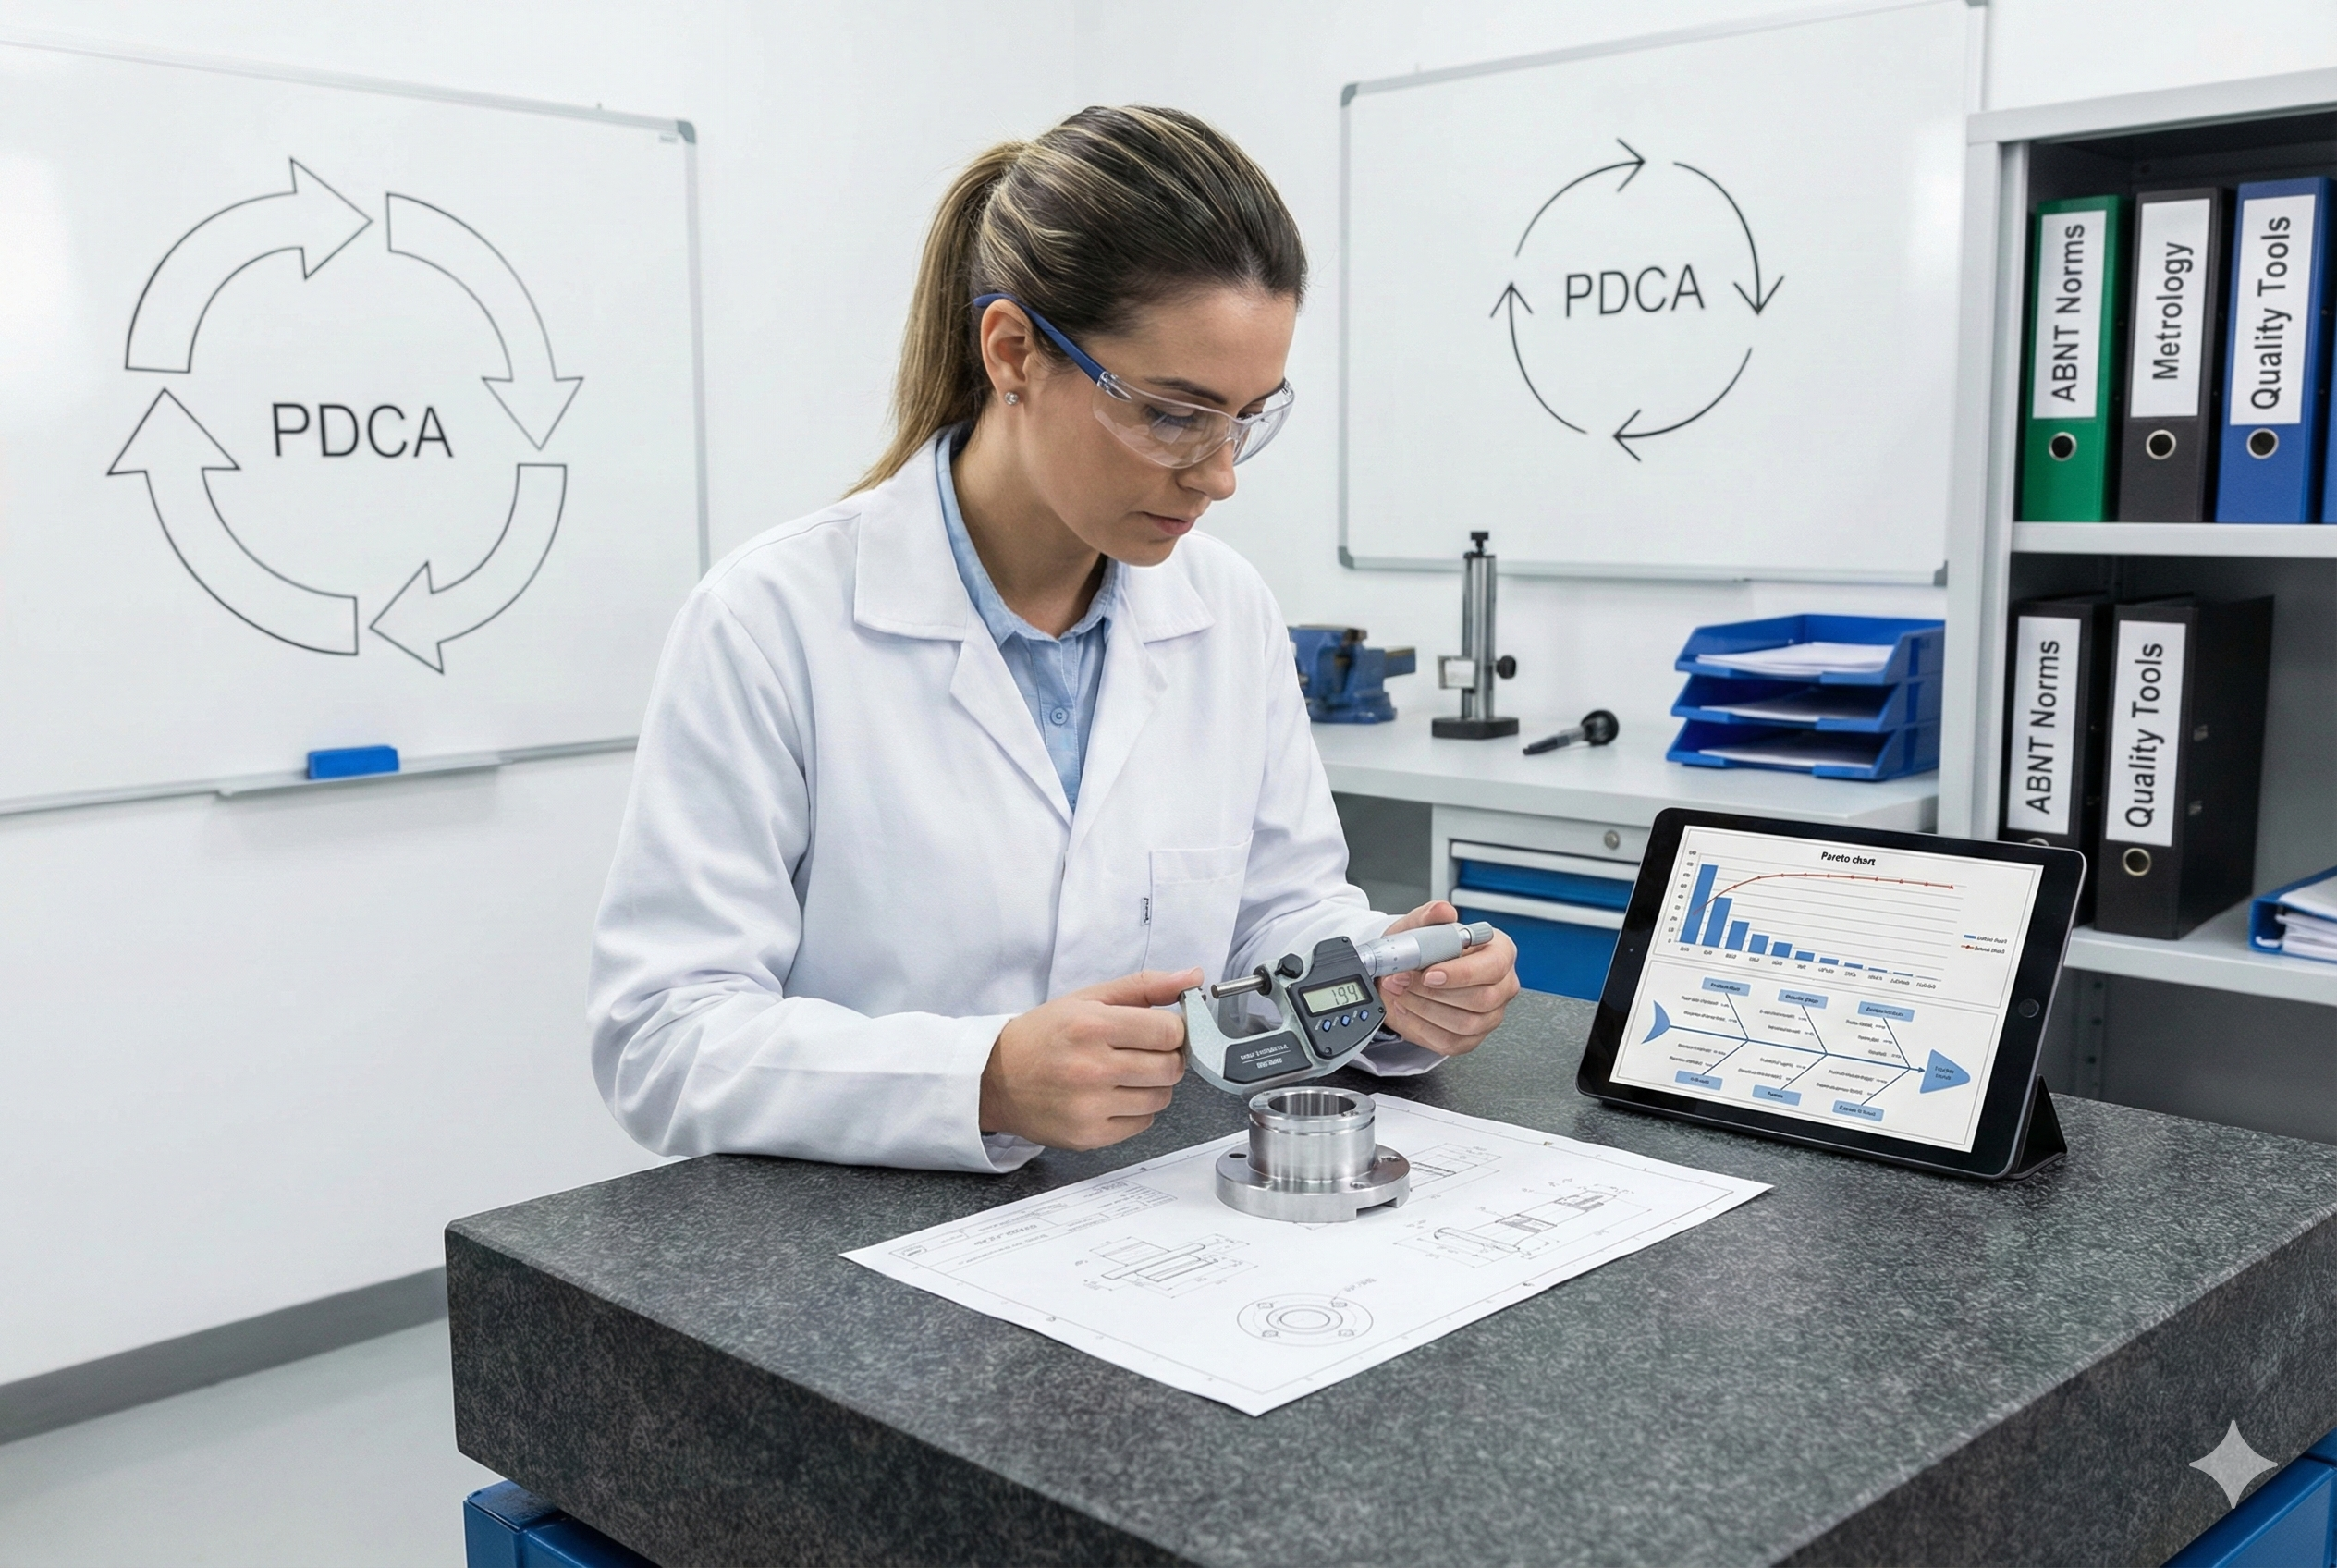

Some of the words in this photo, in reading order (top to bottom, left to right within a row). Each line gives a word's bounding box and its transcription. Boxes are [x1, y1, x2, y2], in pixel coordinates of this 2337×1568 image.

[1565, 263, 1706, 318] PDCA
[2056, 224, 2085, 314] Norms
[2257, 216, 2291, 297] Tools
[2152, 242, 2194, 379] Metrology
[2051, 325, 2079, 402] ABNT
[2250, 308, 2292, 410] Quality
[272, 402, 454, 459] PDCA
[2030, 641, 2060, 728] Norms
[2131, 643, 2163, 718] Tools
[2025, 735, 2054, 815] ABNT
[2124, 729, 2165, 827] Quality
[1820, 851, 1851, 864] Pareto
